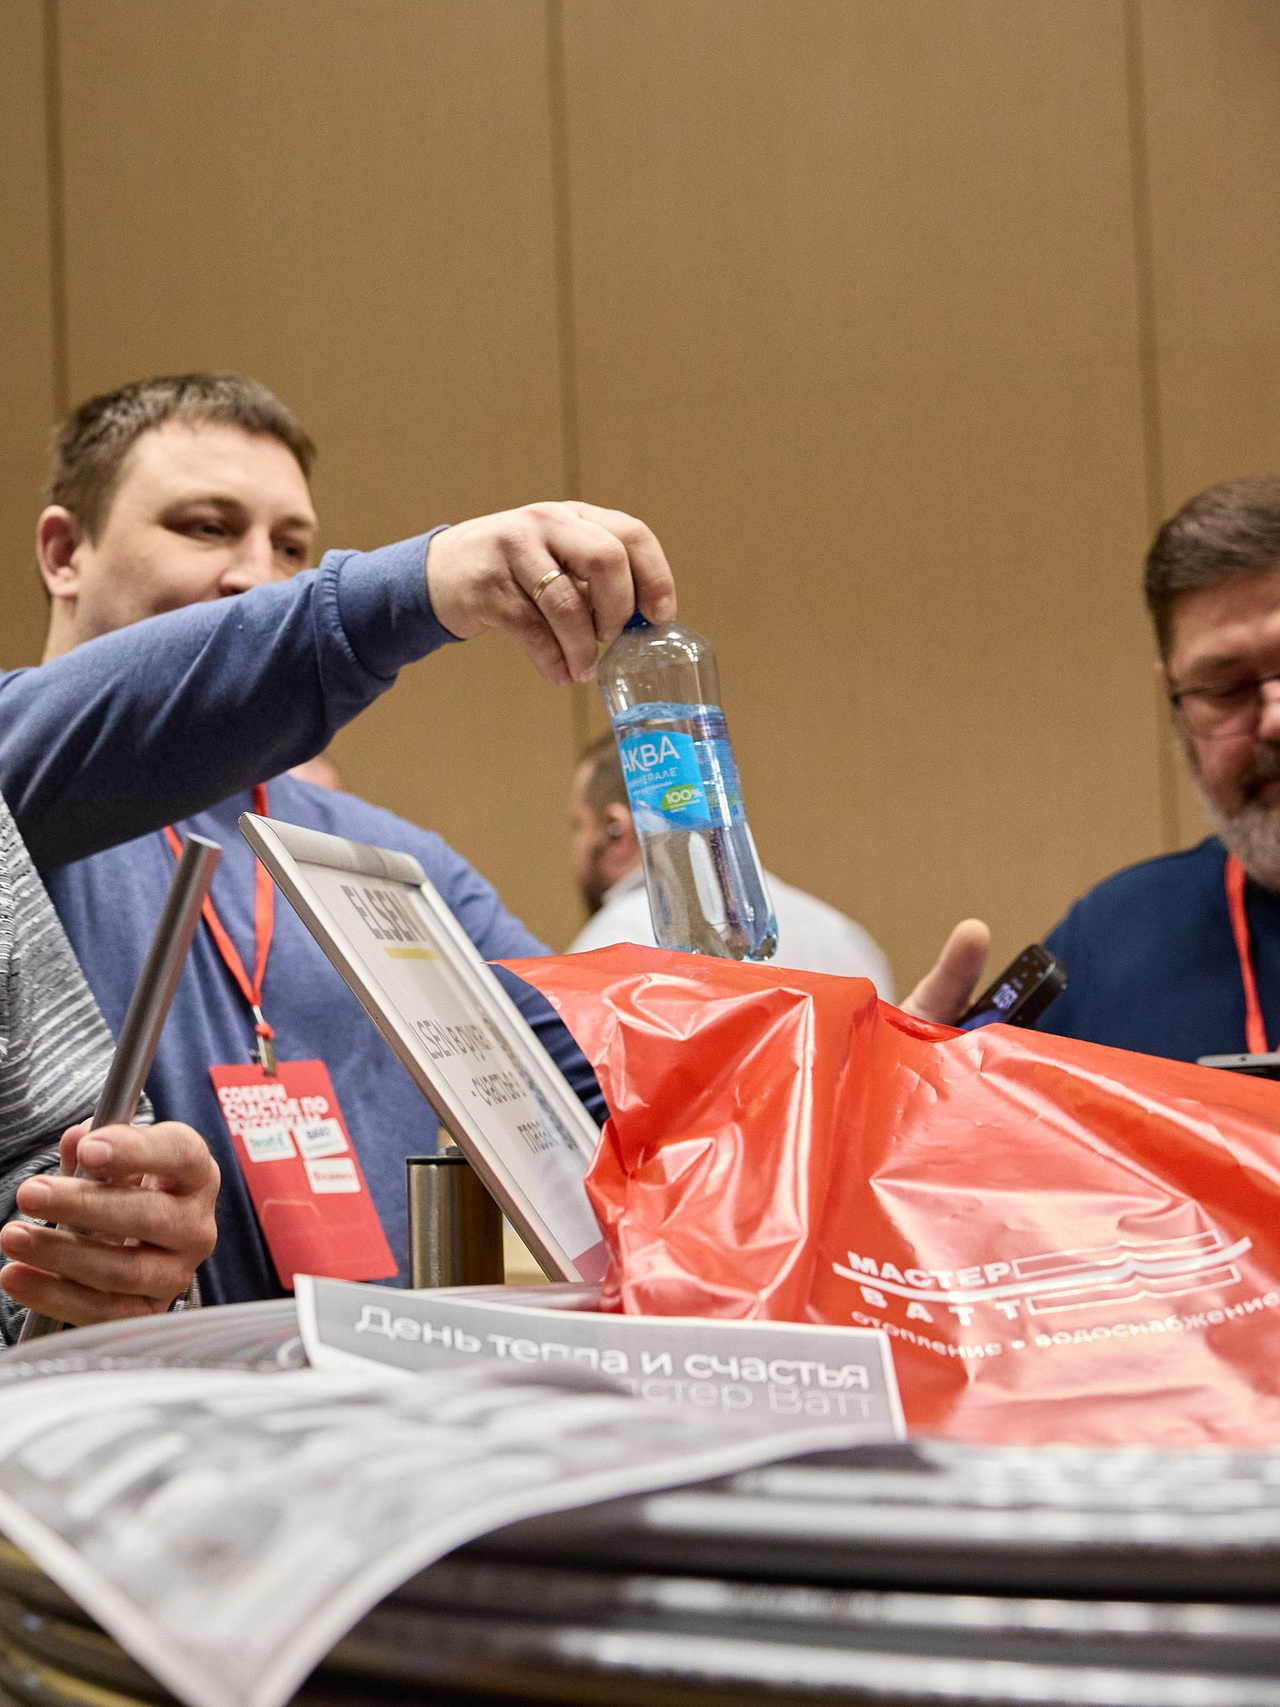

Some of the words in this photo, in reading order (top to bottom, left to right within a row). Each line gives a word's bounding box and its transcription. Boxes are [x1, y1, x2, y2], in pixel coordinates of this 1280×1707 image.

[621, 735, 680, 776] АКВА
[340, 884, 426, 941] ELSEN
[407, 1019, 459, 1060] LSEN
[847, 1250, 1011, 1288] МАСТЕР
[851, 1310, 1002, 1359] отопление
[1035, 1291, 1280, 1348] водоснабжение
[859, 1285, 1021, 1326] ВАТТ
[354, 1304, 483, 1353] День
[640, 1350, 673, 1376] и
[683, 1353, 870, 1391] счастья
[768, 1380, 873, 1420] Ватт
